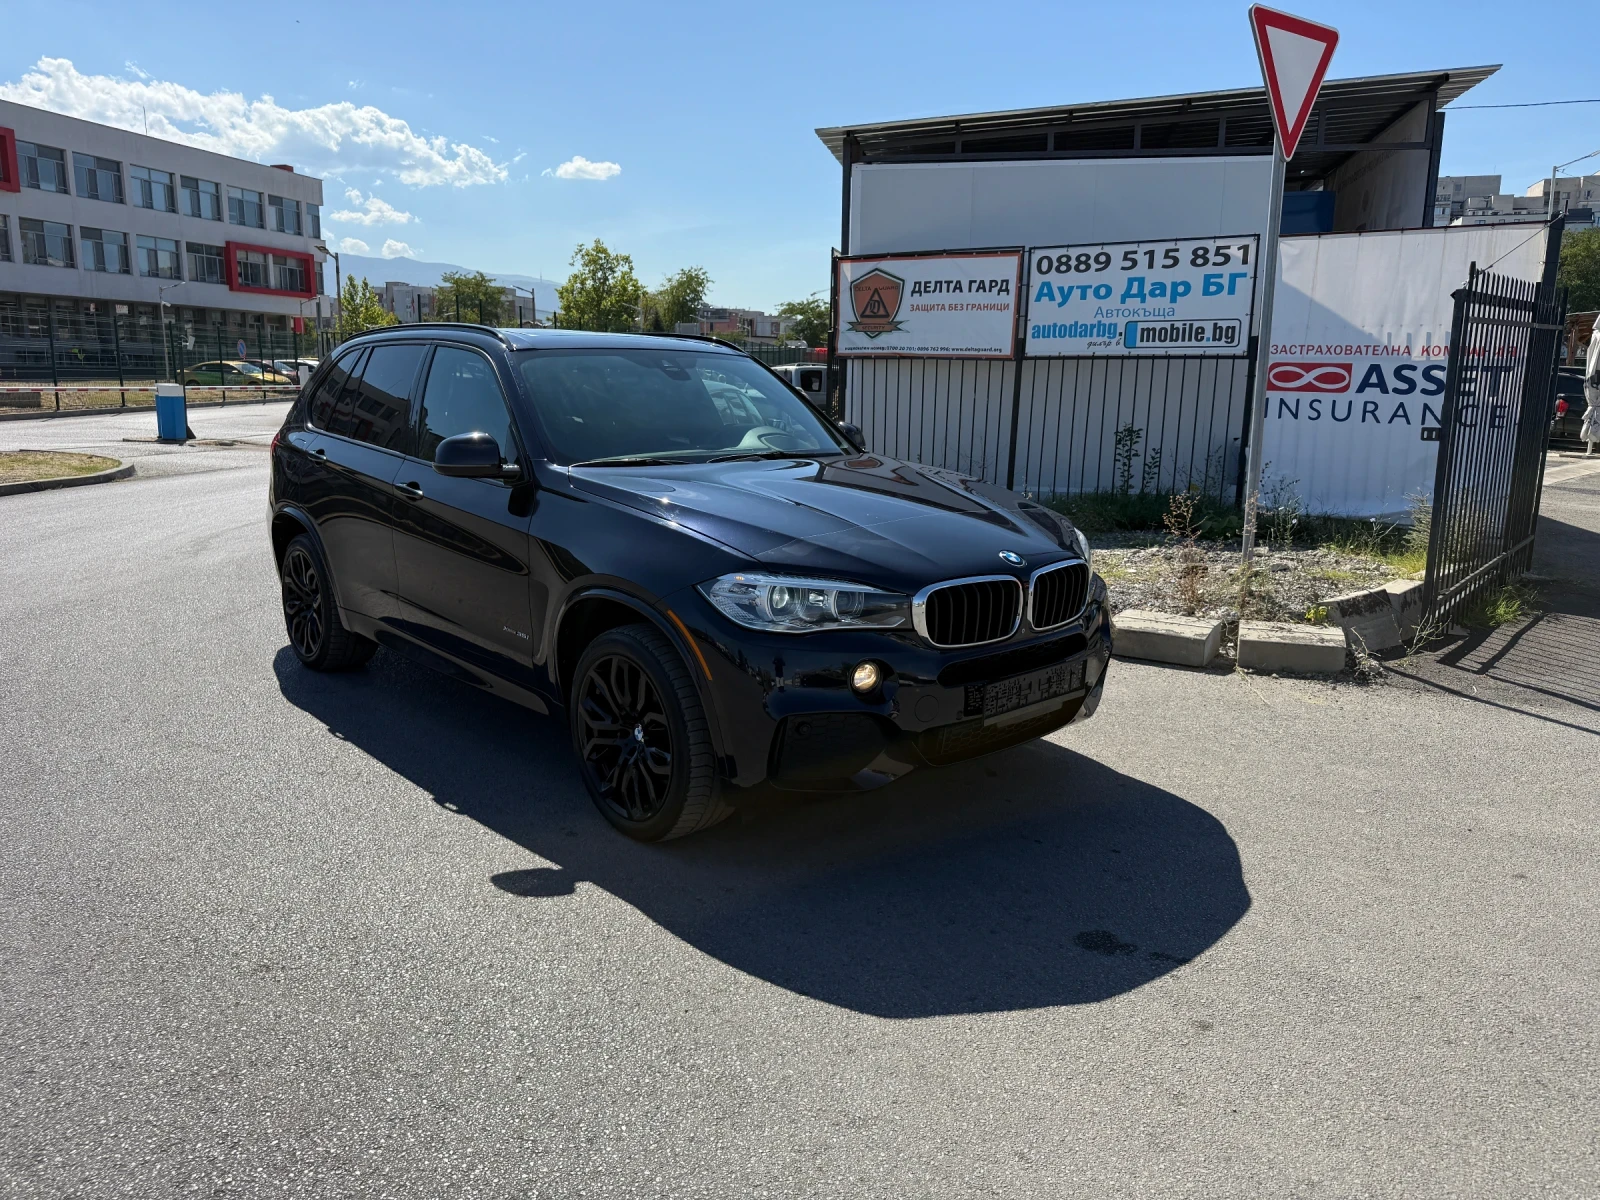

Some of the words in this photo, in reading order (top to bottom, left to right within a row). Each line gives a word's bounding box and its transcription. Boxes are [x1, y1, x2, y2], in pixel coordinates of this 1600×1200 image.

[1036, 252, 1112, 275] 0889
[1120, 248, 1180, 271] 515
[1189, 244, 1250, 268] 851
[910, 280, 964, 297] ДЕЛТА
[968, 279, 1010, 296] ГАРД
[1034, 281, 1113, 308] Ауто
[1120, 276, 1192, 304] Дар
[1201, 272, 1248, 297] БГ
[909, 303, 946, 313] ЗАЩИТА
[948, 303, 964, 312] БЕЗ
[965, 302, 1010, 313] ГРАНИЦИ
[1093, 306, 1176, 319] Автокъща
[1139, 322, 1237, 345] mobile.bg
[1270, 343, 1412, 357] ЗАСТРАХОВАТЕЛНА
